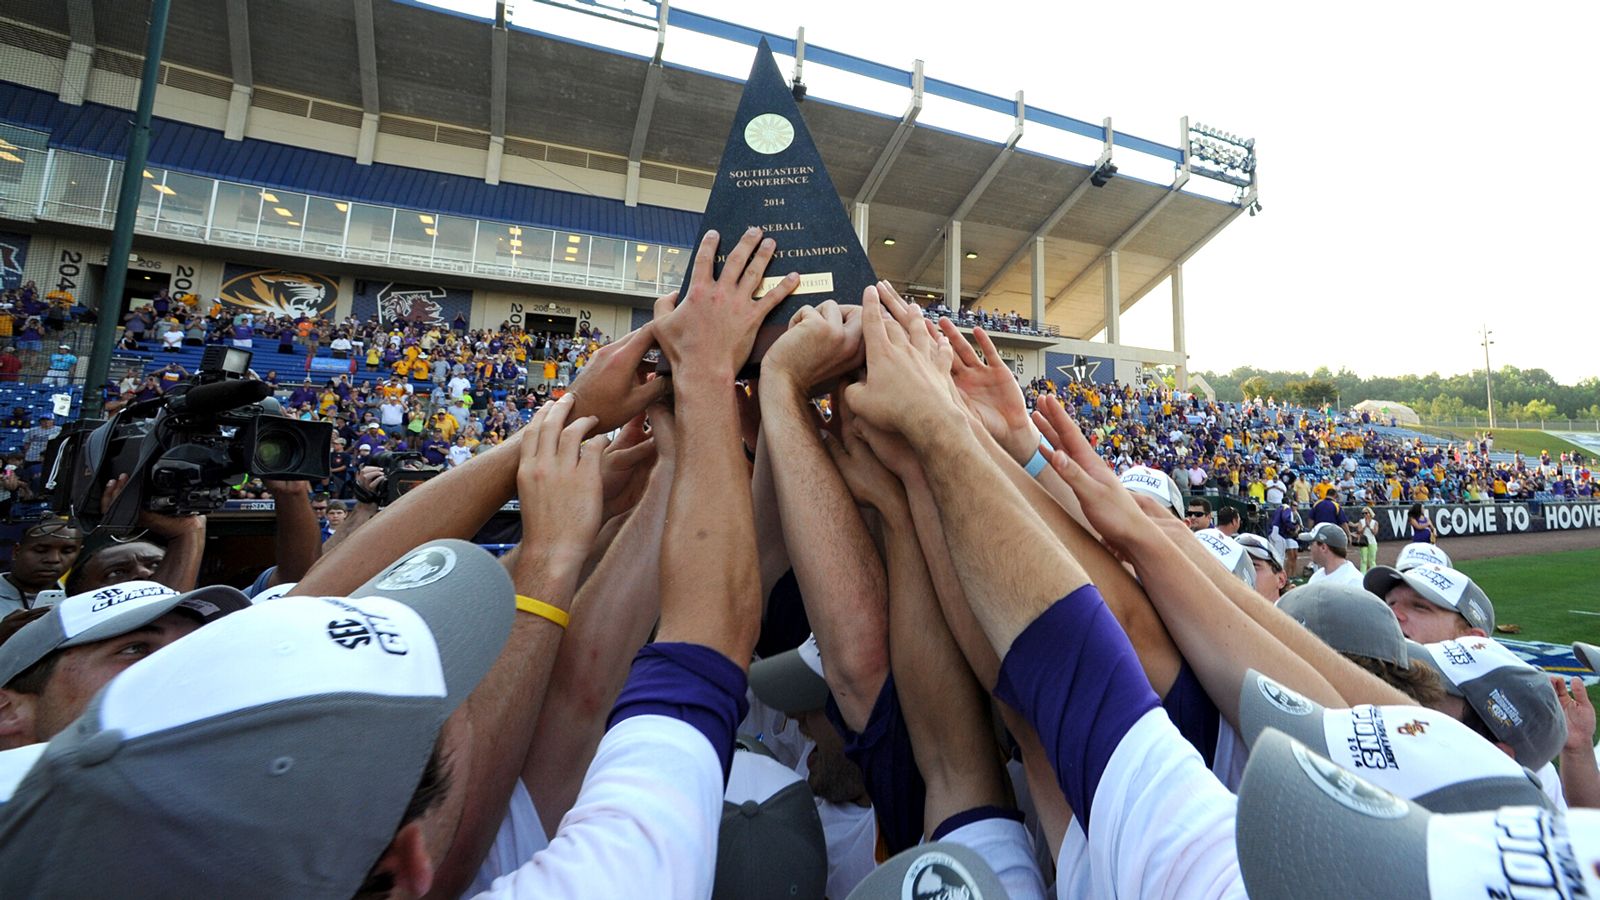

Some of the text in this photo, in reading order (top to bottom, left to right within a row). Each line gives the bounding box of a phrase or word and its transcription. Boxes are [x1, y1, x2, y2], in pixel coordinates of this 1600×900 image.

[729, 166, 814, 178] SOUTHEASTERN
[736, 176, 809, 188] CONFERENCE
[763, 198, 785, 206] 2014
[787, 246, 848, 258] CHAMPION
[56, 250, 82, 290] 204
[1016, 353, 1025, 375] 212
[1502, 505, 1530, 531] TO
[92, 588, 124, 600] SEC
